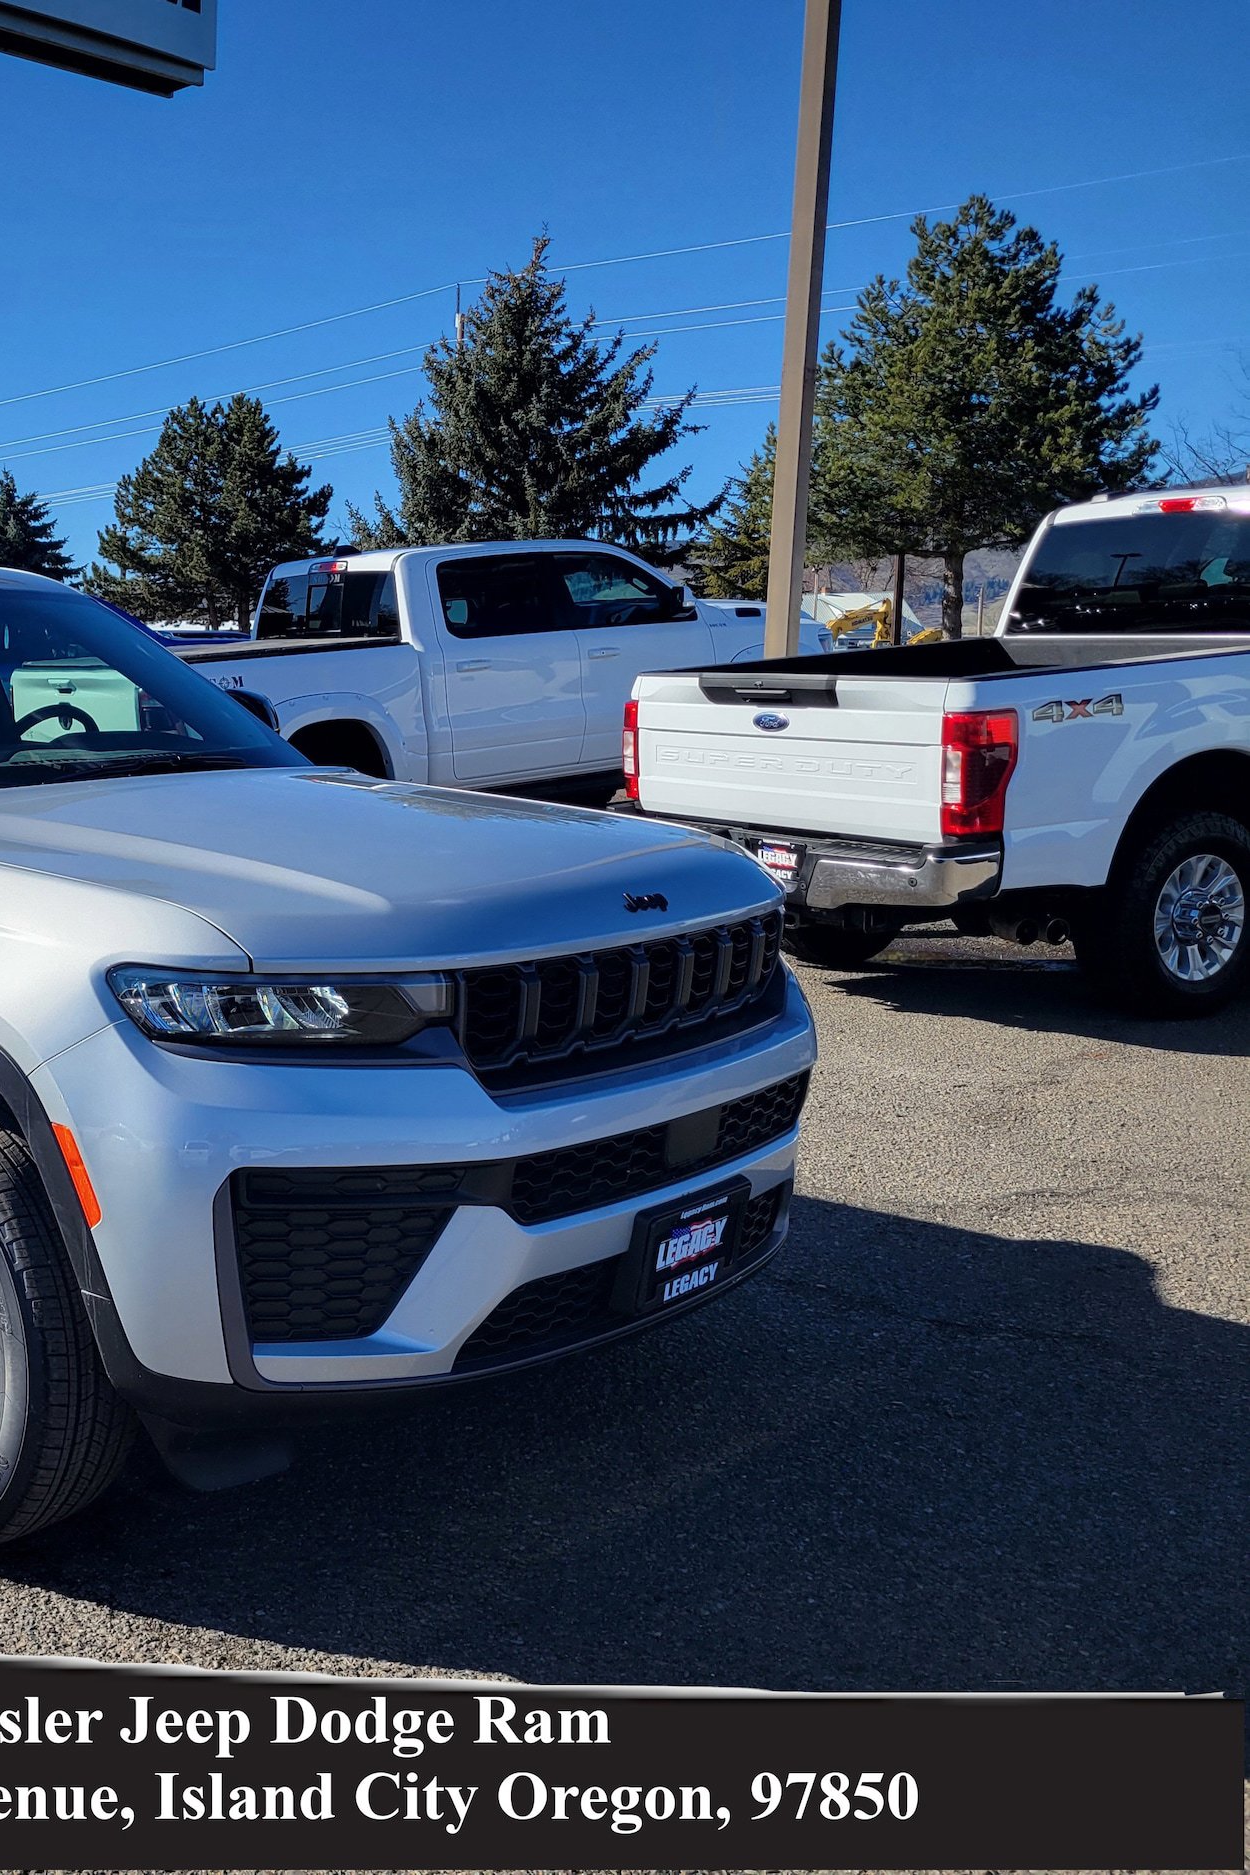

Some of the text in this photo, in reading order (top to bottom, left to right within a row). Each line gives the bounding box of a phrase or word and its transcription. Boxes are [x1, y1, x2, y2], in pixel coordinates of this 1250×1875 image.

[660, 749, 913, 779] SUPER DUTY
[757, 849, 798, 866] LEGACY
[622, 892, 668, 912] Jeep
[656, 1217, 728, 1271] LEGACY
[663, 1262, 719, 1302] LEGACY
